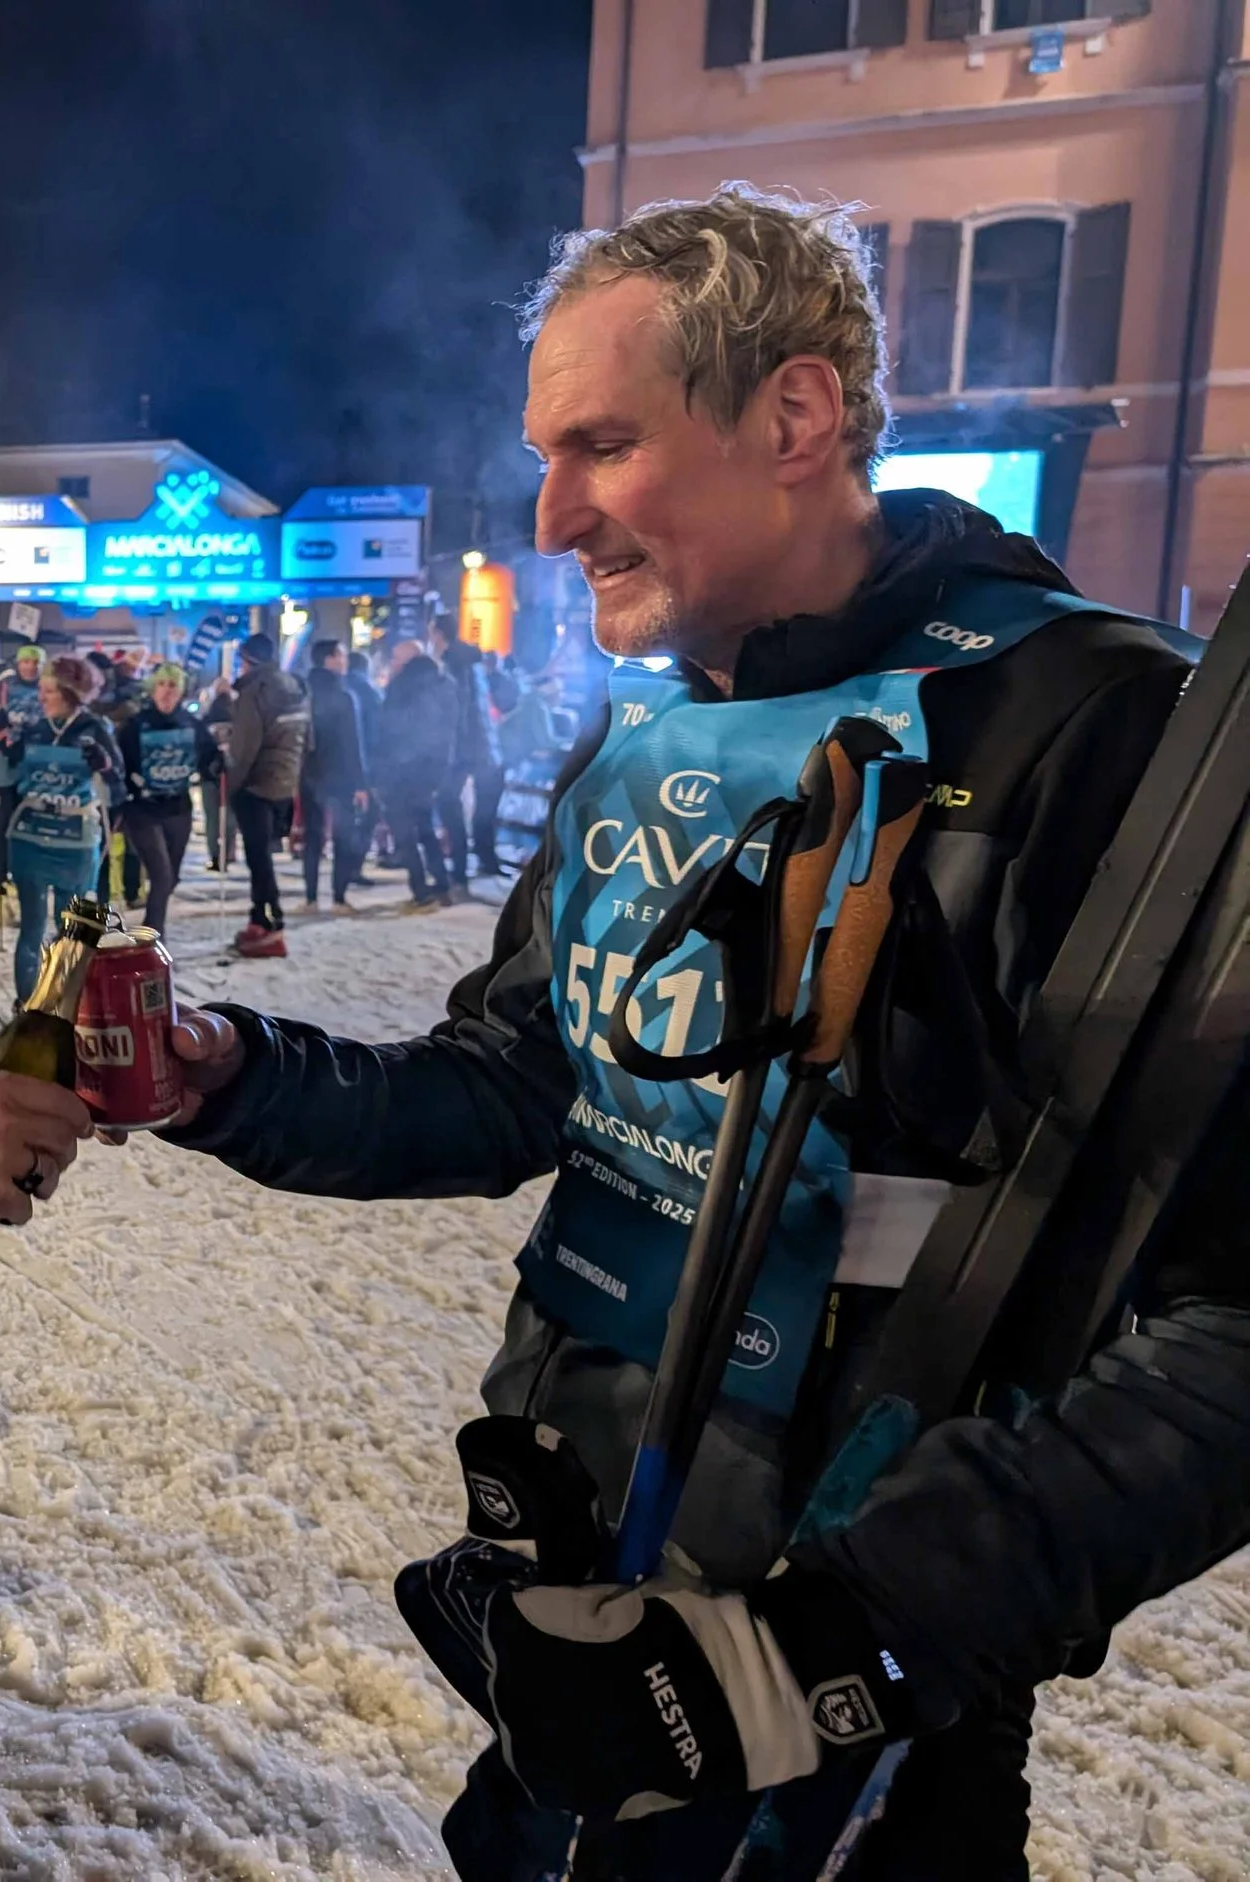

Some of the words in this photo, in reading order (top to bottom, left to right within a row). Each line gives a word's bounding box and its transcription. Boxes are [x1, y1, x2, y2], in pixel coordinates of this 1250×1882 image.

[924, 621, 996, 652] coop
[566, 942, 732, 1098] 551
[572, 1096, 744, 1191] MARCIALONG
[652, 1193, 697, 1226] 2025
[643, 1661, 704, 1781] HESTRA
